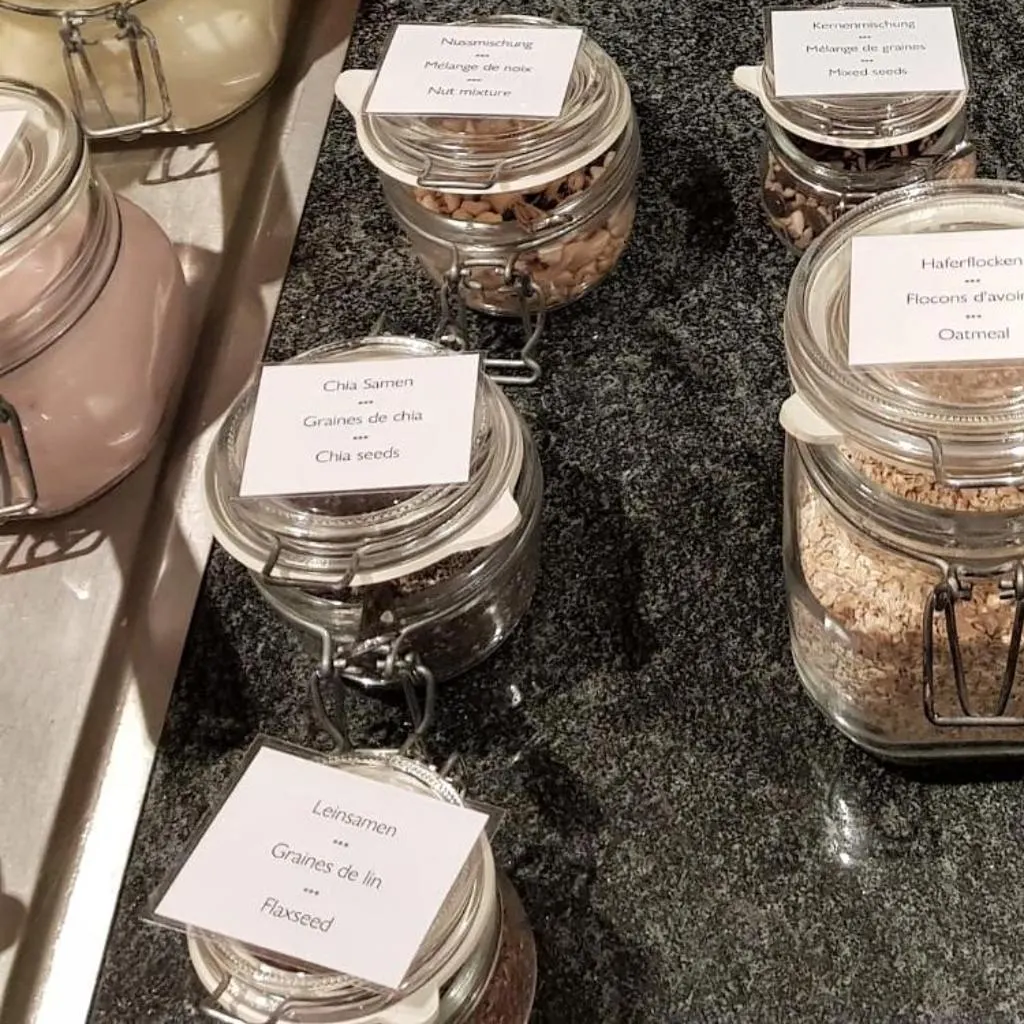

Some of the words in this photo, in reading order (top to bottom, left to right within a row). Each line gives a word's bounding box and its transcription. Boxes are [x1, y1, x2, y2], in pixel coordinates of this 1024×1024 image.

[441, 37, 534, 51] Nussmischung
[806, 43, 859, 55] Mélange
[862, 43, 879, 53] de
[882, 42, 927, 54] graines
[483, 62, 501, 72] de
[503, 63, 534, 73] noix
[828, 68, 868, 78] Mixed
[872, 67, 908, 77] seeds
[427, 85, 455, 96] Nut
[458, 86, 512, 97] mixture
[922, 254, 1024, 270] Haferflocken
[906, 291, 968, 305] Flocons
[938, 327, 1011, 342] Oatmeal
[323, 378, 358, 393] Chia
[363, 376, 414, 391] Samen
[303, 413, 363, 428] Graines
[368, 411, 388, 425] de
[393, 409, 423, 423] chia
[315, 449, 351, 464] Chia
[357, 446, 400, 461] seeds
[311, 798, 398, 838] Leinsamen
[270, 842, 333, 875] Graines
[336, 862, 359, 883] de
[361, 869, 383, 890] lin
[259, 896, 335, 934] Flaxseed
